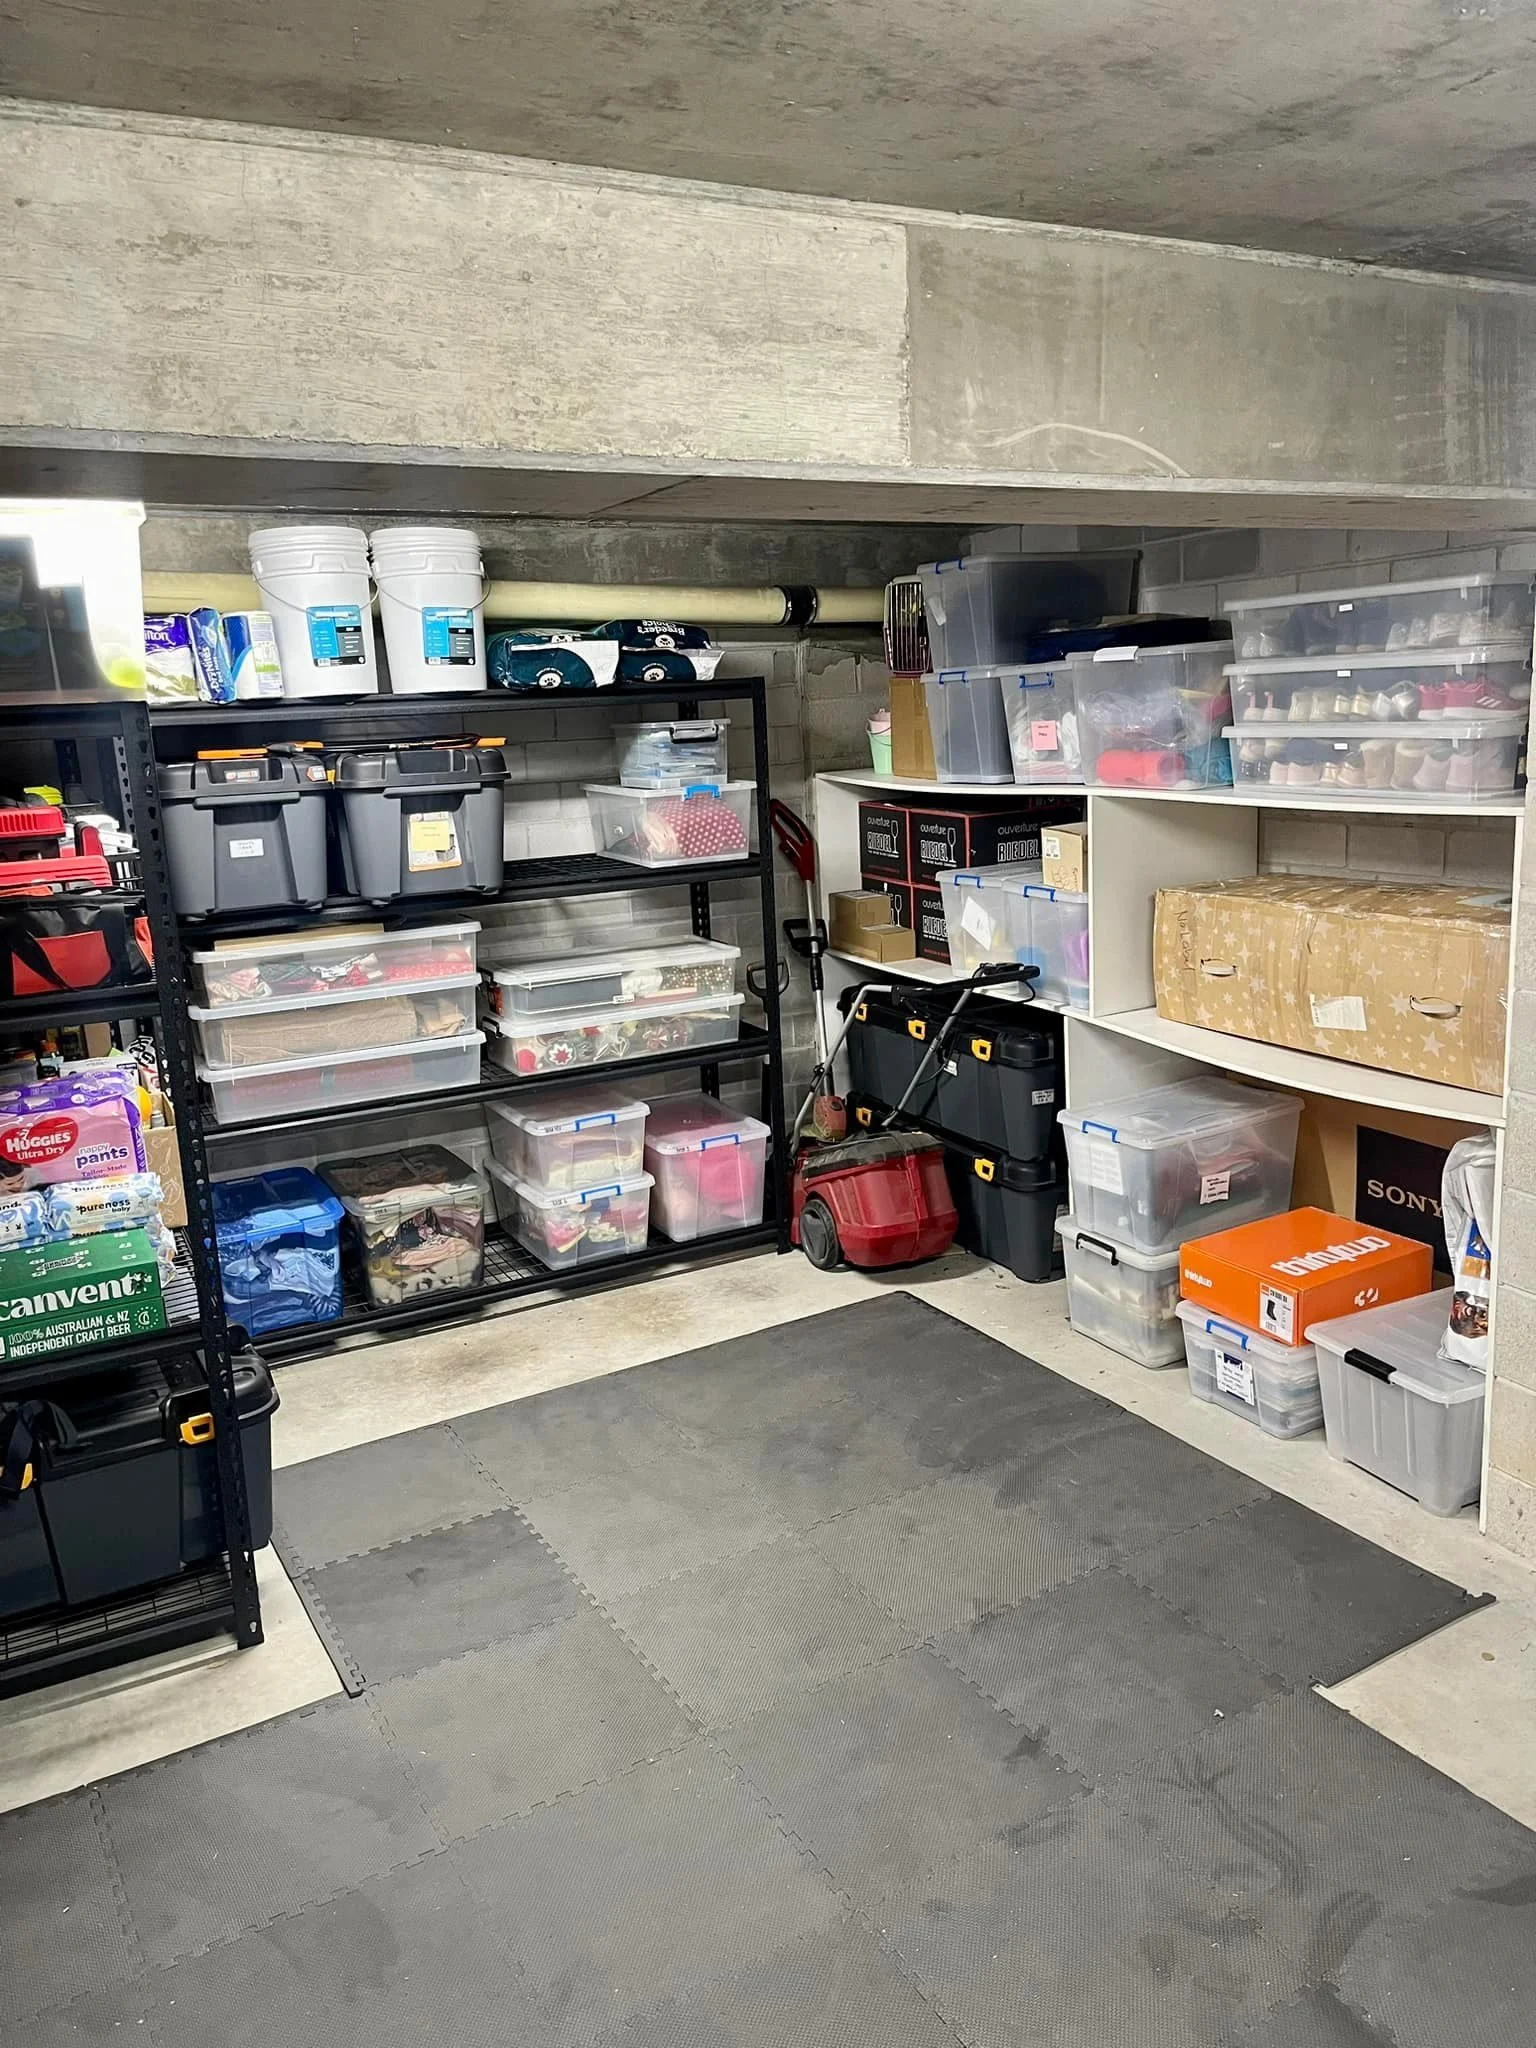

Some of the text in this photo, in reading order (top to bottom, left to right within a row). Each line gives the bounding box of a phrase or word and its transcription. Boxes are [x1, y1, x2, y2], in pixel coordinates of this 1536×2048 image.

[920, 823, 946, 836] ouverture
[997, 821, 1038, 836] ouverture
[867, 831, 892, 854] RIEDEL
[920, 839, 949, 864] RIEDEL
[997, 839, 1040, 863] RIEDEL
[5, 1131, 72, 1153] HUGGIES
[16, 1145, 66, 1161] Ultra Dry
[79, 1142, 110, 1155] nappy
[76, 1146, 128, 1169] pants
[76, 1199, 131, 1216] pureness
[1367, 1179, 1443, 1218] SONY
[8, 1310, 130, 1345] 100% AUSTRALIAN & NZ
[10, 1323, 132, 1358] INDEPENDENT CRAFT BEER
